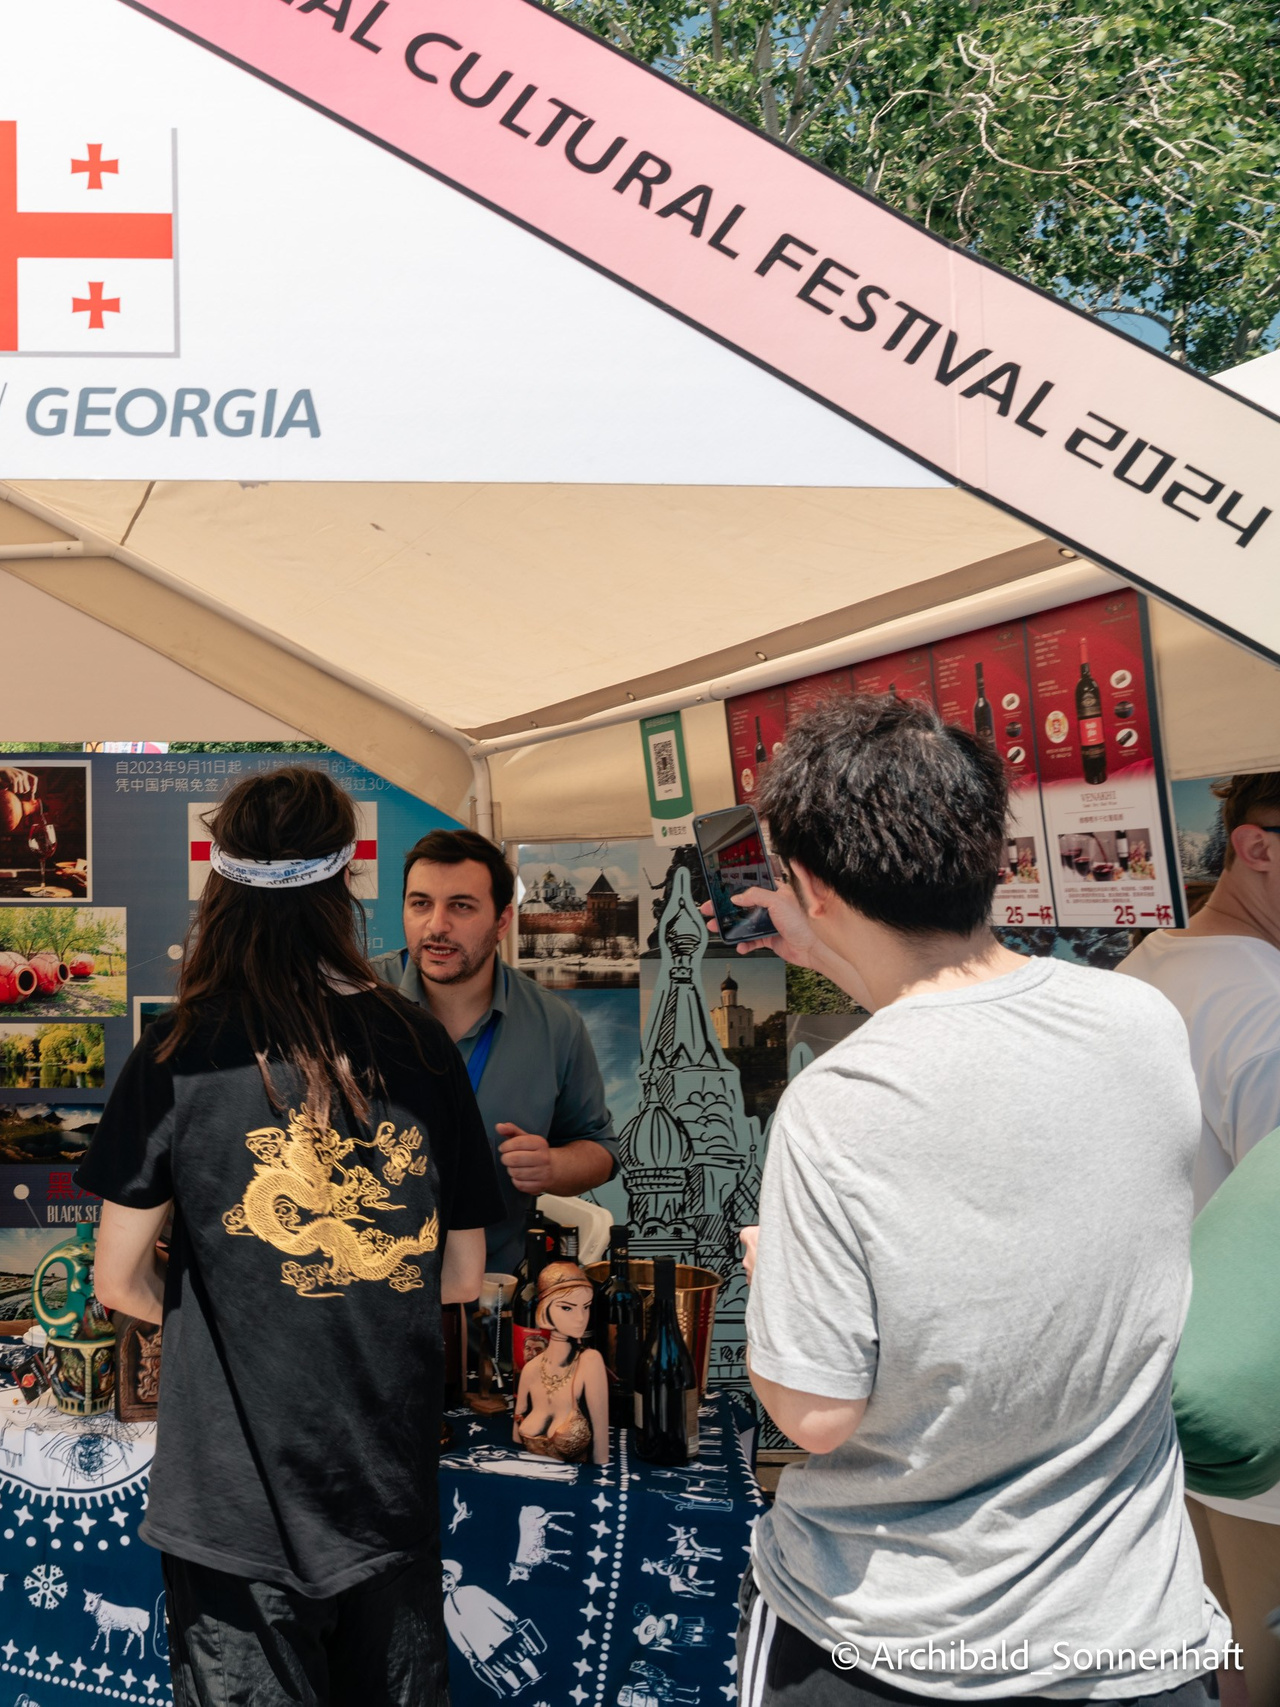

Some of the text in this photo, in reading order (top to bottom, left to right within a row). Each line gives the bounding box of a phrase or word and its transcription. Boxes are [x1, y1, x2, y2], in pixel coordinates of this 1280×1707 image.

[277, 0, 1272, 549] AL CULTURAL FESTIVAL 2024
[25, 387, 322, 438] GEORGIA
[1005, 905, 1024, 925] 25
[1113, 904, 1137, 926] 25
[47, 1204, 104, 1223] BLACK SE
